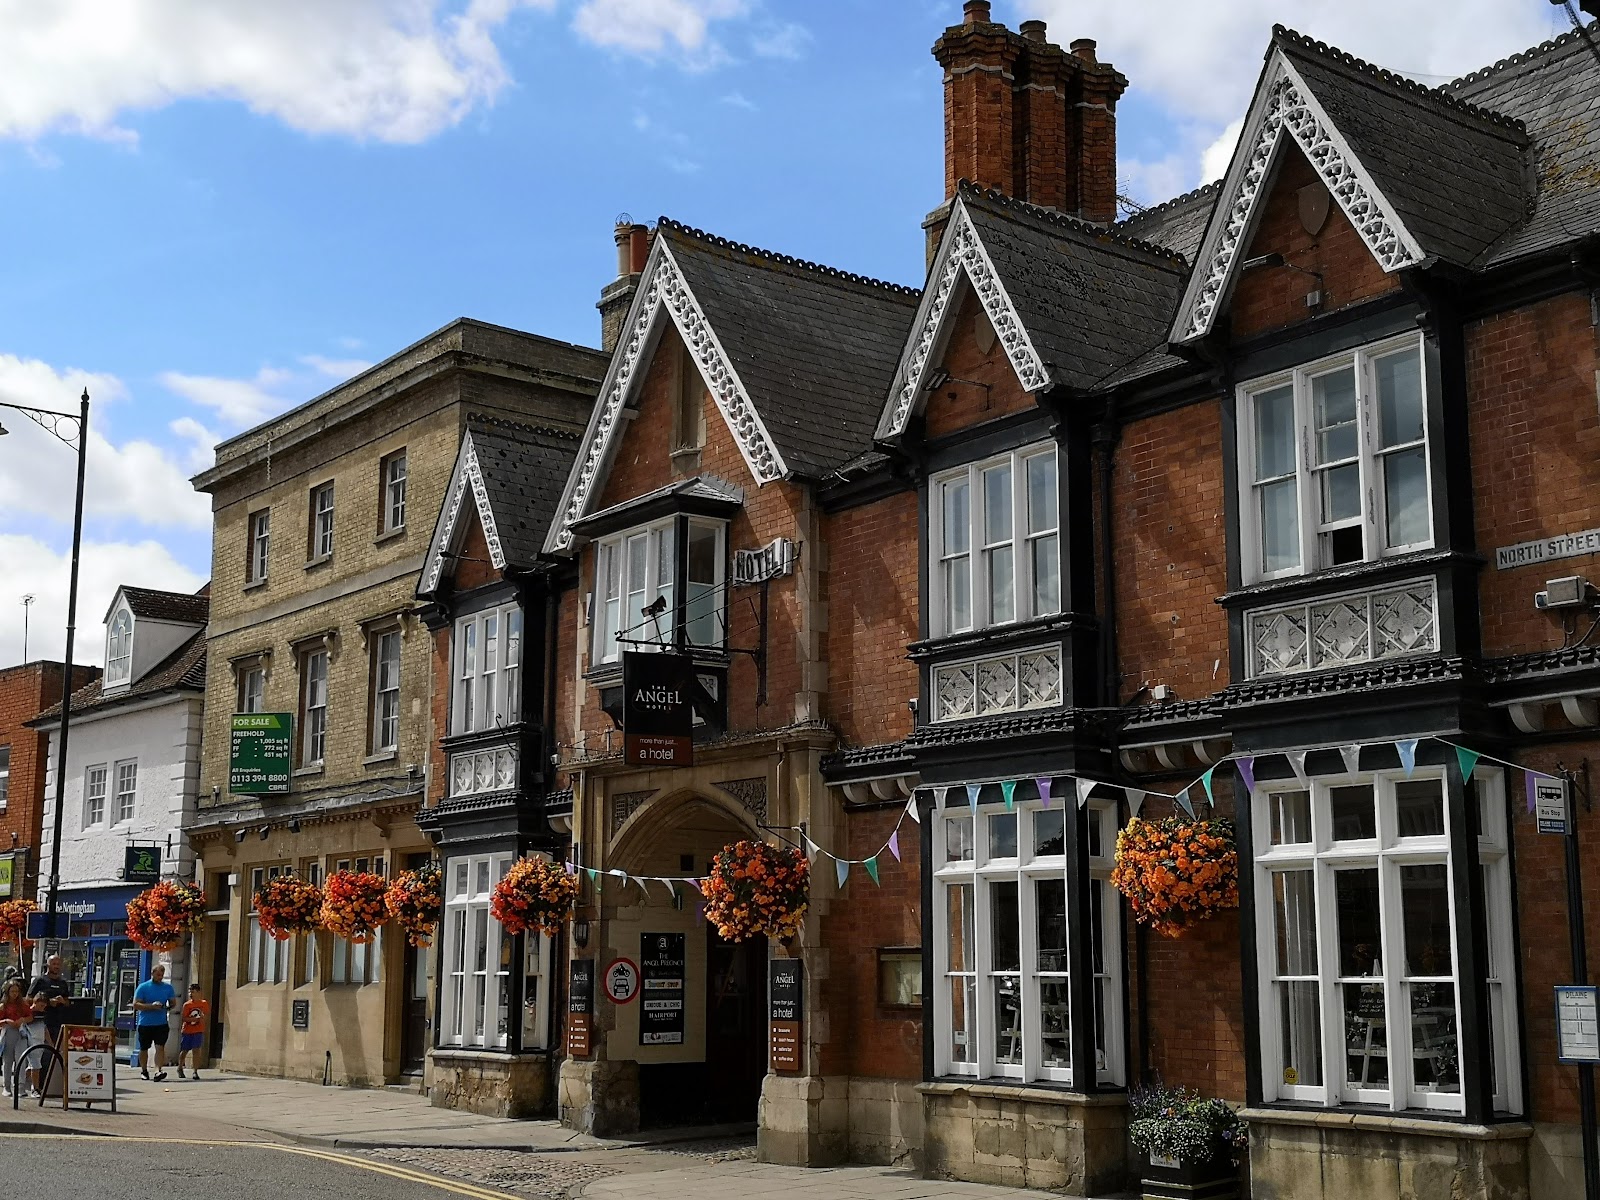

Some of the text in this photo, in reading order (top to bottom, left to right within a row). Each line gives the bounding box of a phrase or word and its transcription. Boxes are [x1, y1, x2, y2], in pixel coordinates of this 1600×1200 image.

[1500, 532, 1600, 564] NORTH STREET
[736, 541, 778, 580] HOTEL
[636, 688, 682, 704] ANGEL
[640, 748, 674, 759] a hotel
[63, 900, 95, 917] Nottingham
[773, 1008, 793, 1018] a hotel
